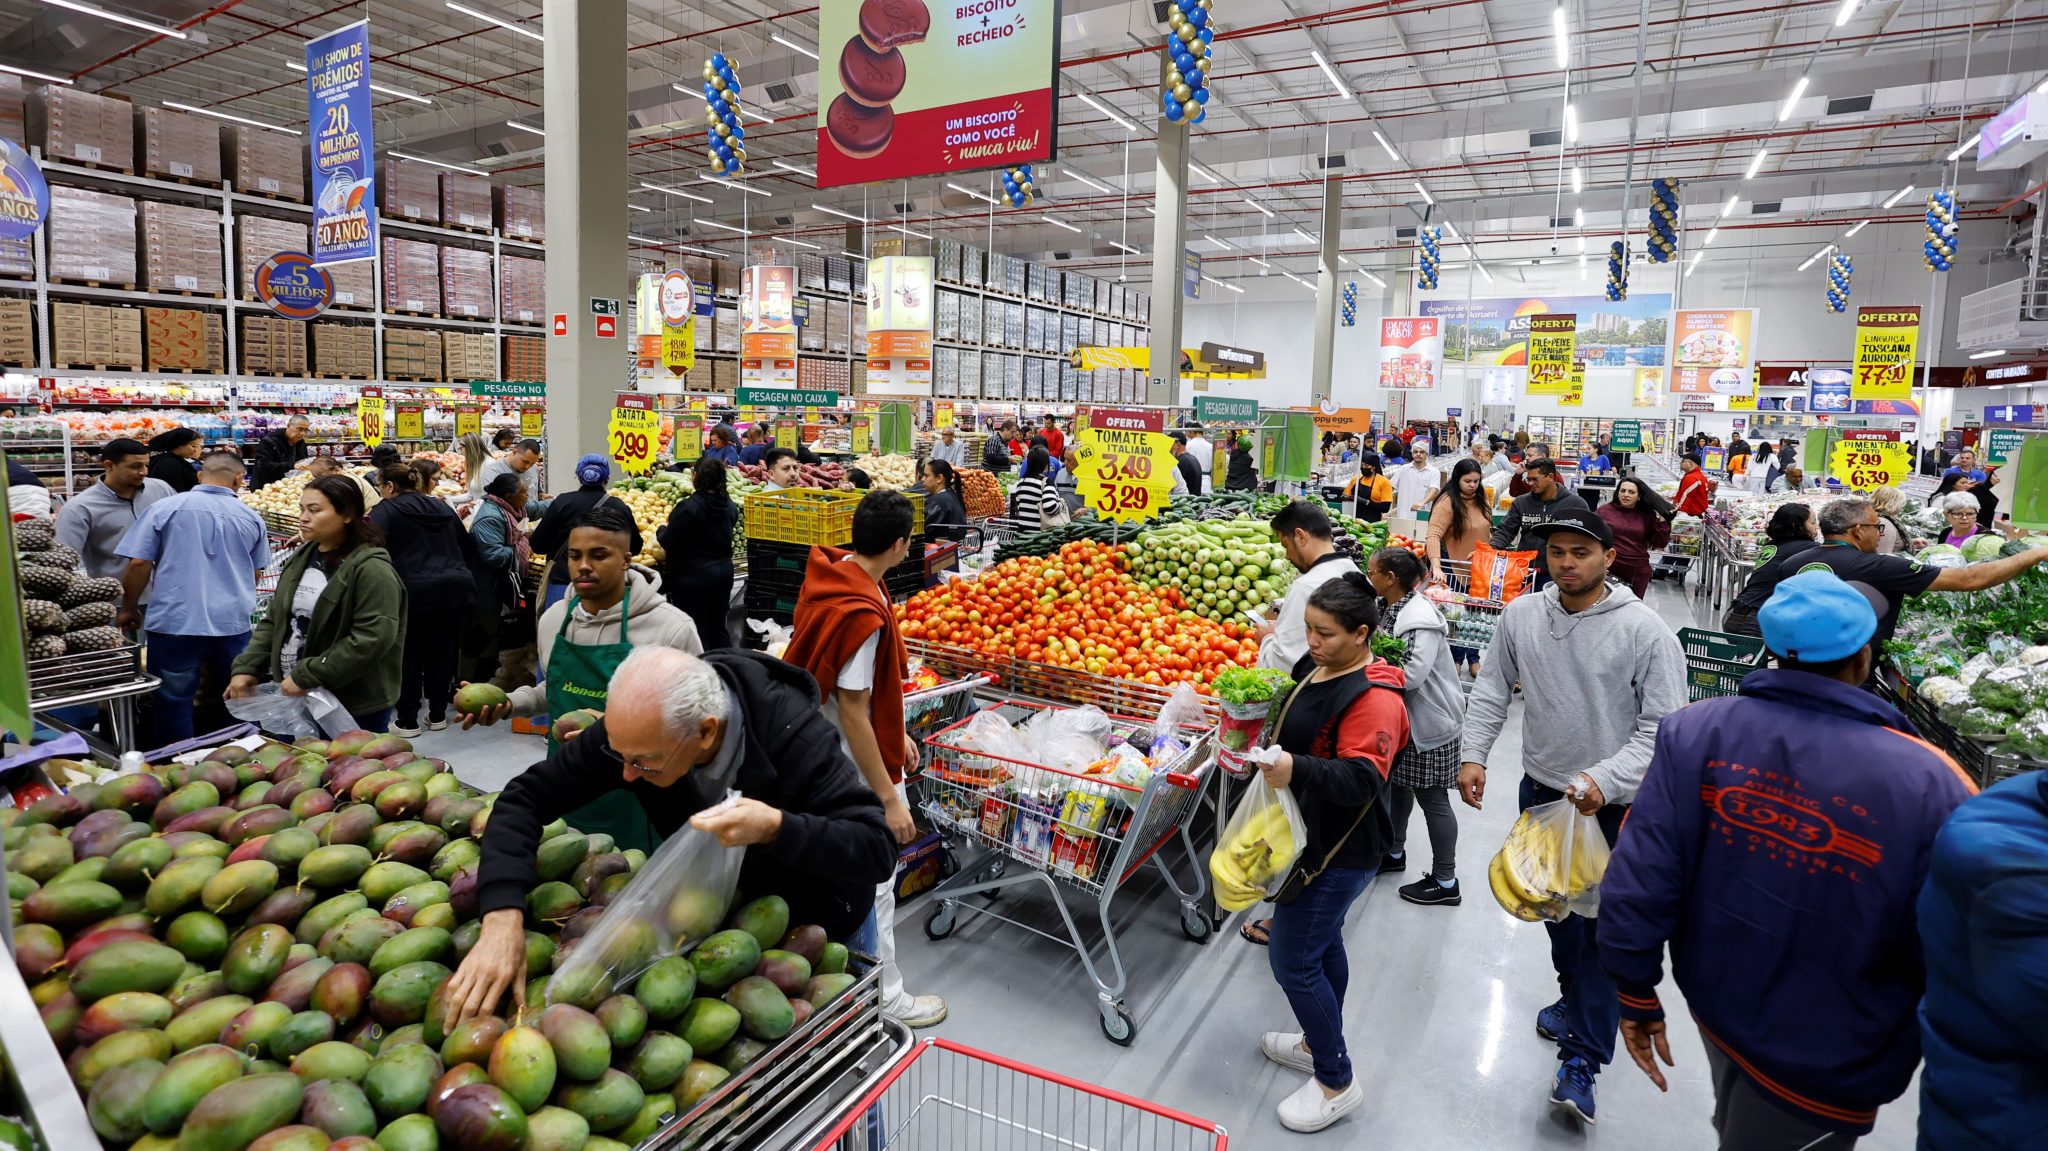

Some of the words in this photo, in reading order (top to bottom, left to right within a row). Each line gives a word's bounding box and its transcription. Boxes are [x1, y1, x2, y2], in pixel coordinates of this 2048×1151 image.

[956, 0, 1016, 19] BISCOITO
[957, 25, 1014, 46] RECHEIO
[311, 56, 324, 71] UM
[325, 47, 349, 66] SHOW
[351, 42, 363, 58] DE
[311, 60, 363, 92] PRÊMIOS!
[327, 103, 349, 136] 20
[946, 119, 963, 130] UM
[966, 110, 1017, 126] BISCOITO
[319, 131, 358, 154] MILHÕES
[945, 133, 980, 146] COMO
[984, 124, 1015, 142] VOCÊ
[960, 141, 1004, 160] nunca
[1007, 129, 1039, 153] viu!
[334, 221, 368, 243] ANOS
[292, 265, 309, 286] 5
[267, 285, 327, 298] MILHÕES
[1532, 320, 1575, 328] OFERTA
[1859, 313, 1919, 322] OFERTA
[1386, 328, 1413, 338] SABOR
[1865, 335, 1905, 343] LINGUIÇA
[1552, 338, 1570, 347] PEIXE
[1862, 344, 1911, 353] TOSCANA
[1861, 354, 1900, 363] AURORA
[484, 385, 526, 393] PESAGEM
[624, 400, 645, 408] OFERTA
[749, 392, 788, 402] PESAGEM
[791, 394, 802, 402] NO
[805, 394, 827, 403] CAIXA
[617, 408, 646, 420] BATATA
[1205, 402, 1229, 415] PESAGEM
[1230, 404, 1238, 415] NO
[1240, 404, 1252, 416] CAIXA
[1106, 417, 1146, 428] OFERTA
[1095, 430, 1147, 445] TOMATE
[1080, 448, 1092, 459] KG
[1107, 444, 1153, 456] ITALIANO
[1832, 796, 1878, 824] CO.
[1729, 801, 1823, 841] 1983
[1748, 834, 1862, 884] ORIGINAL
